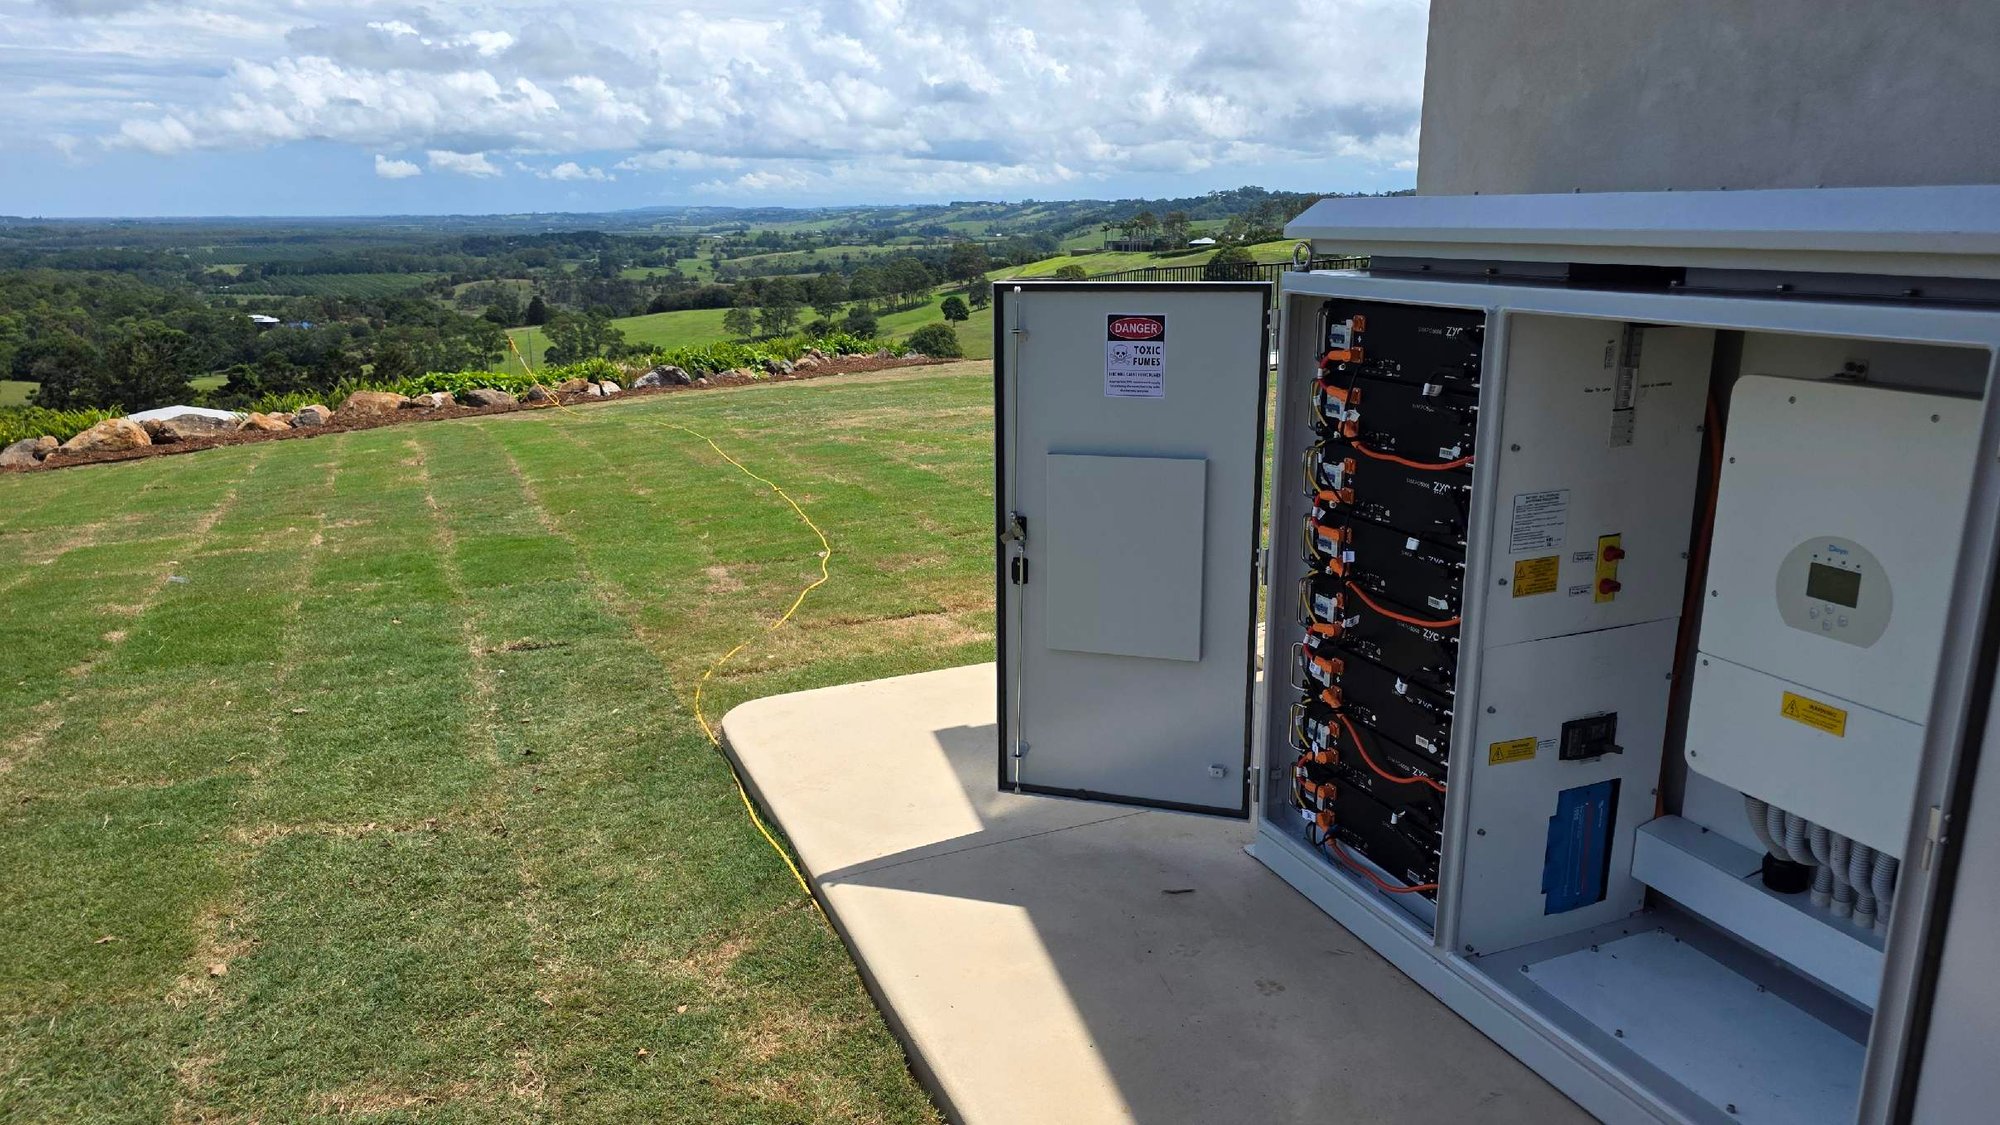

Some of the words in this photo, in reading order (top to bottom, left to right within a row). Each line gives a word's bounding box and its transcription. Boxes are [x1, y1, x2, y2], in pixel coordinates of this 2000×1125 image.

[1115, 323, 1157, 334] DANGER
[1134, 345, 1160, 355] TOXIC
[1133, 357, 1160, 366] FUMES
